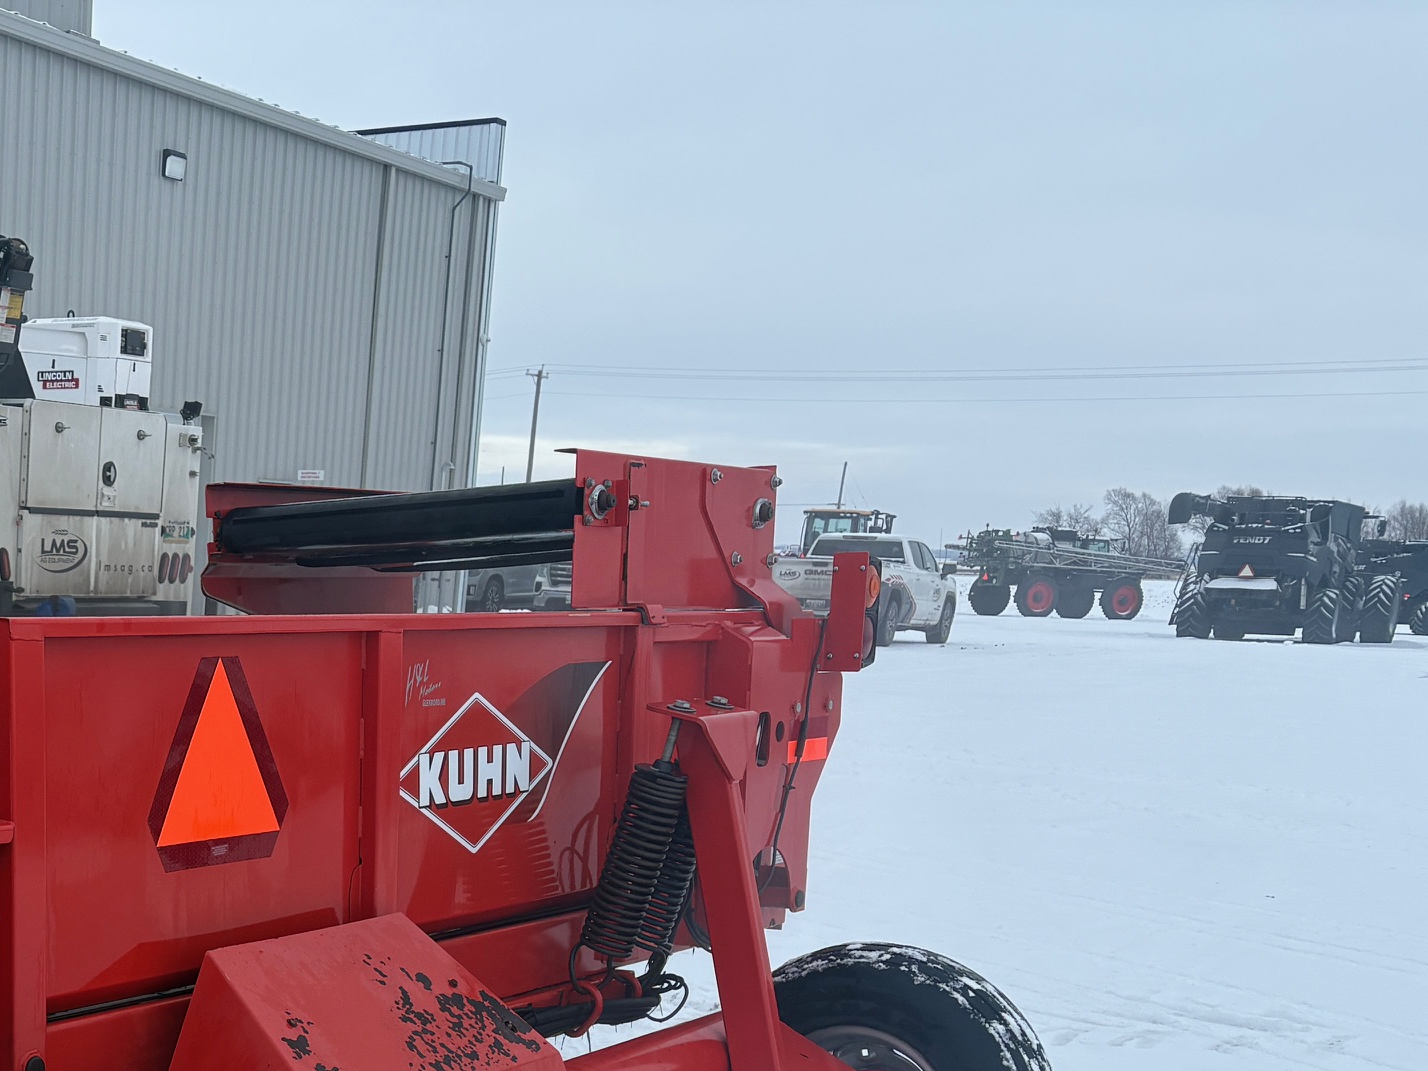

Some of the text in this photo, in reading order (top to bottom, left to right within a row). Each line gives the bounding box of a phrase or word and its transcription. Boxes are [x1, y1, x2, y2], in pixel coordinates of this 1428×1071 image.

[39, 371, 73, 381] LINCOLN
[46, 381, 76, 389] ELECTRIC
[1233, 536, 1272, 544] FENDT
[40, 538, 79, 555] LMS
[418, 740, 531, 809] KUHN
